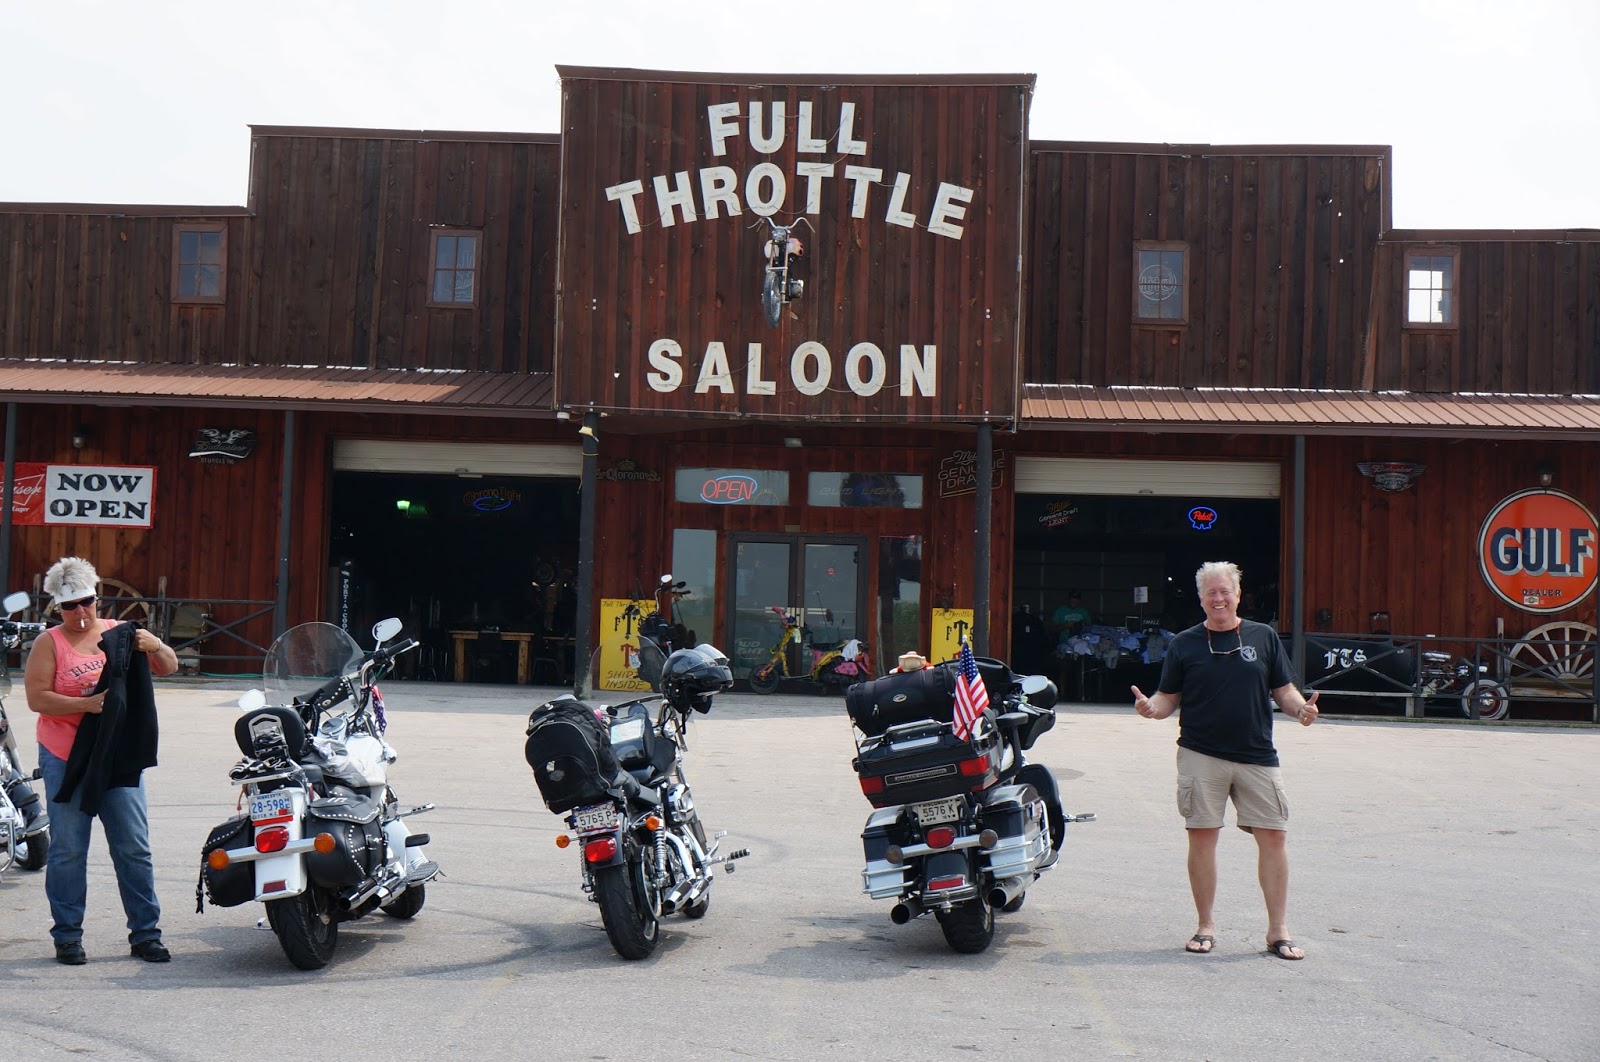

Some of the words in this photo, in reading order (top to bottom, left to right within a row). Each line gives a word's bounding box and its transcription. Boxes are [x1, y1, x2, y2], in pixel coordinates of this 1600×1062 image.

[707, 101, 867, 156] FULL
[605, 161, 975, 240] THROTTLE
[646, 338, 937, 397] SALOON
[57, 472, 144, 494] NOW
[605, 468, 646, 481] Corona
[702, 479, 754, 500] OPEN
[50, 499, 149, 520] OPEN
[1193, 510, 1214, 521] Pabst
[1490, 527, 1594, 577] GULF
[1522, 588, 1562, 597] DEALER
[605, 680, 642, 690] INSIDE
[251, 798, 284, 813] 28-598
[922, 805, 946, 817] 5576
[948, 803, 955, 813] K
[579, 812, 604, 825] 5765
[605, 810, 612, 820] P
